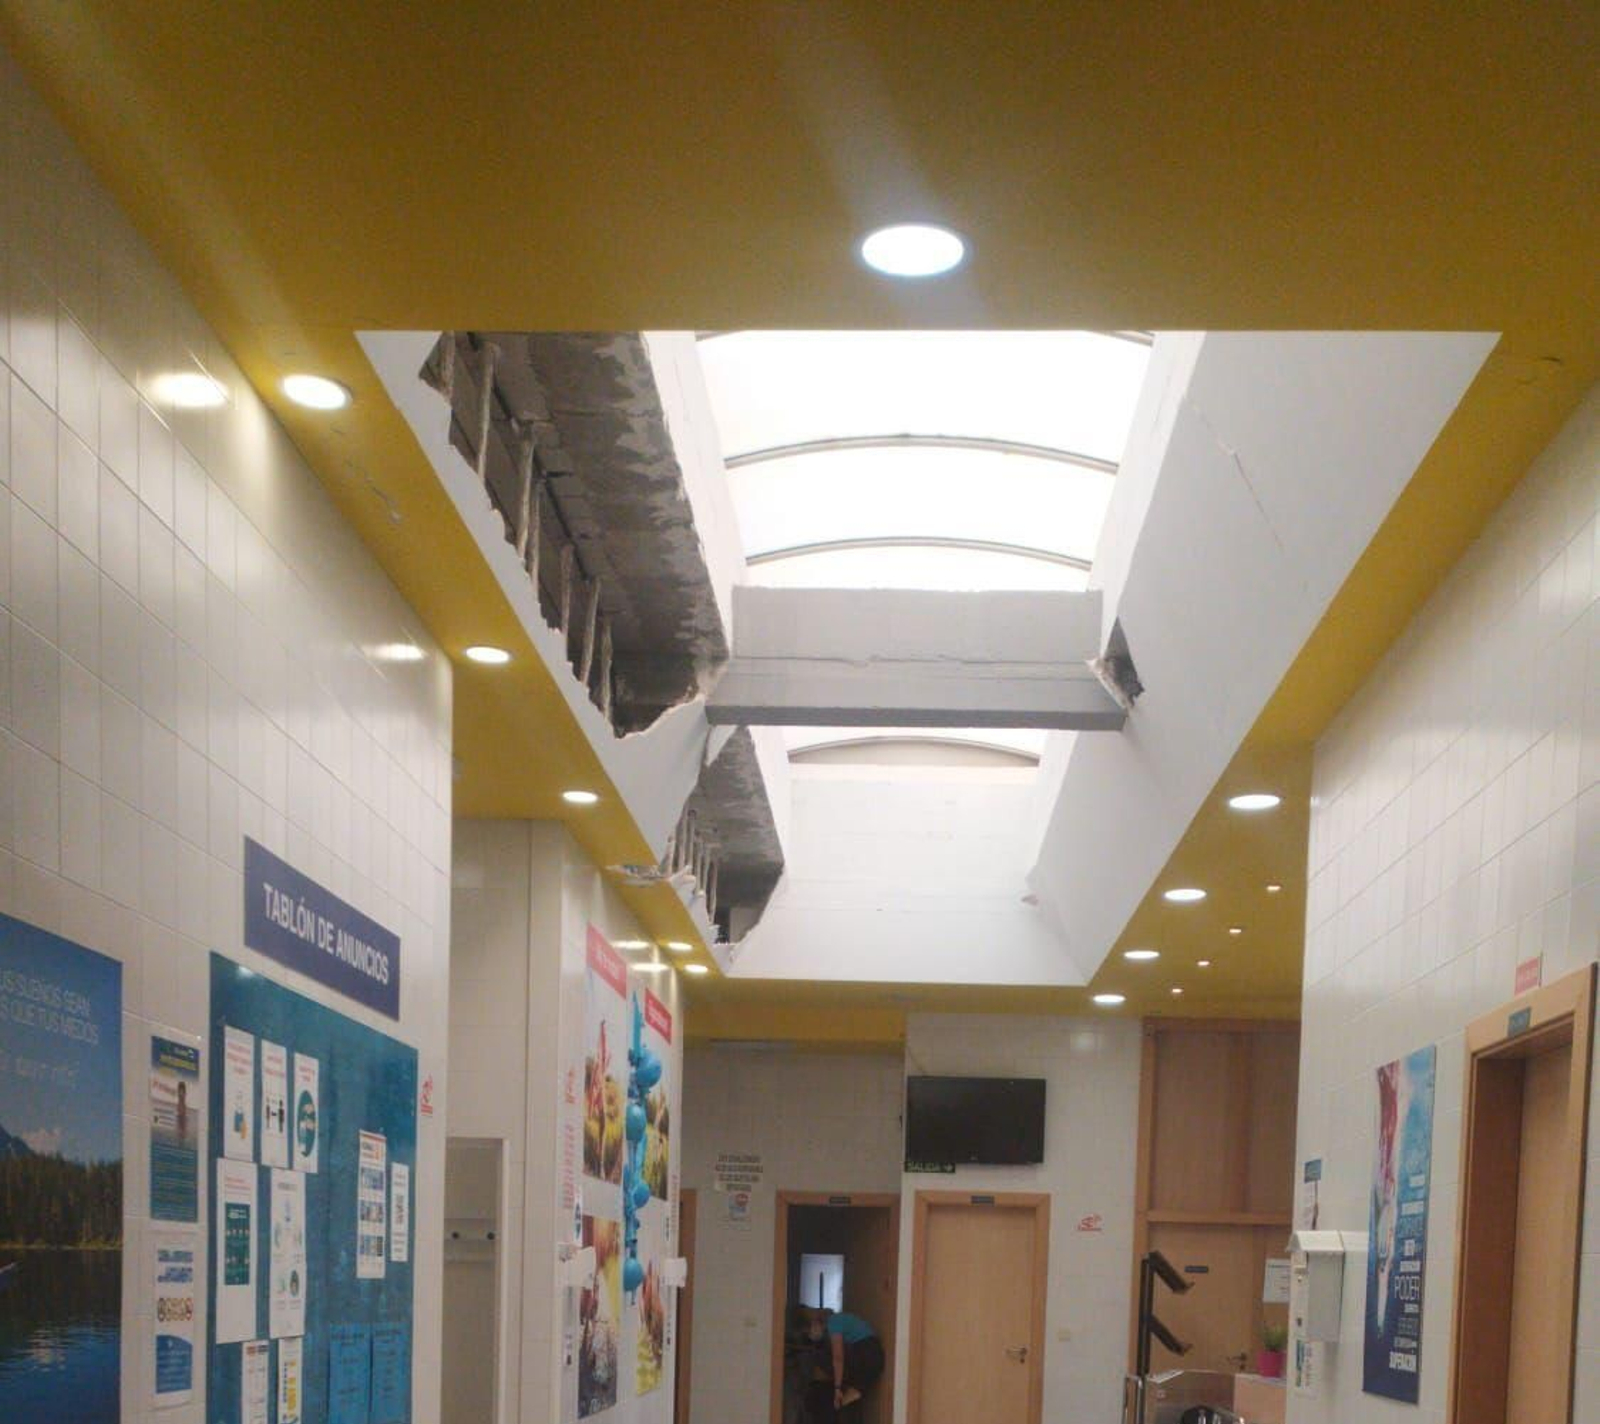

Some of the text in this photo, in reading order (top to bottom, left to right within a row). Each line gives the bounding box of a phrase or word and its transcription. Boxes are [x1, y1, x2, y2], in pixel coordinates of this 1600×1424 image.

[263, 881, 389, 985] TABLÓN DE ANUNCIOS
[1394, 1274, 1421, 1301] PODER
